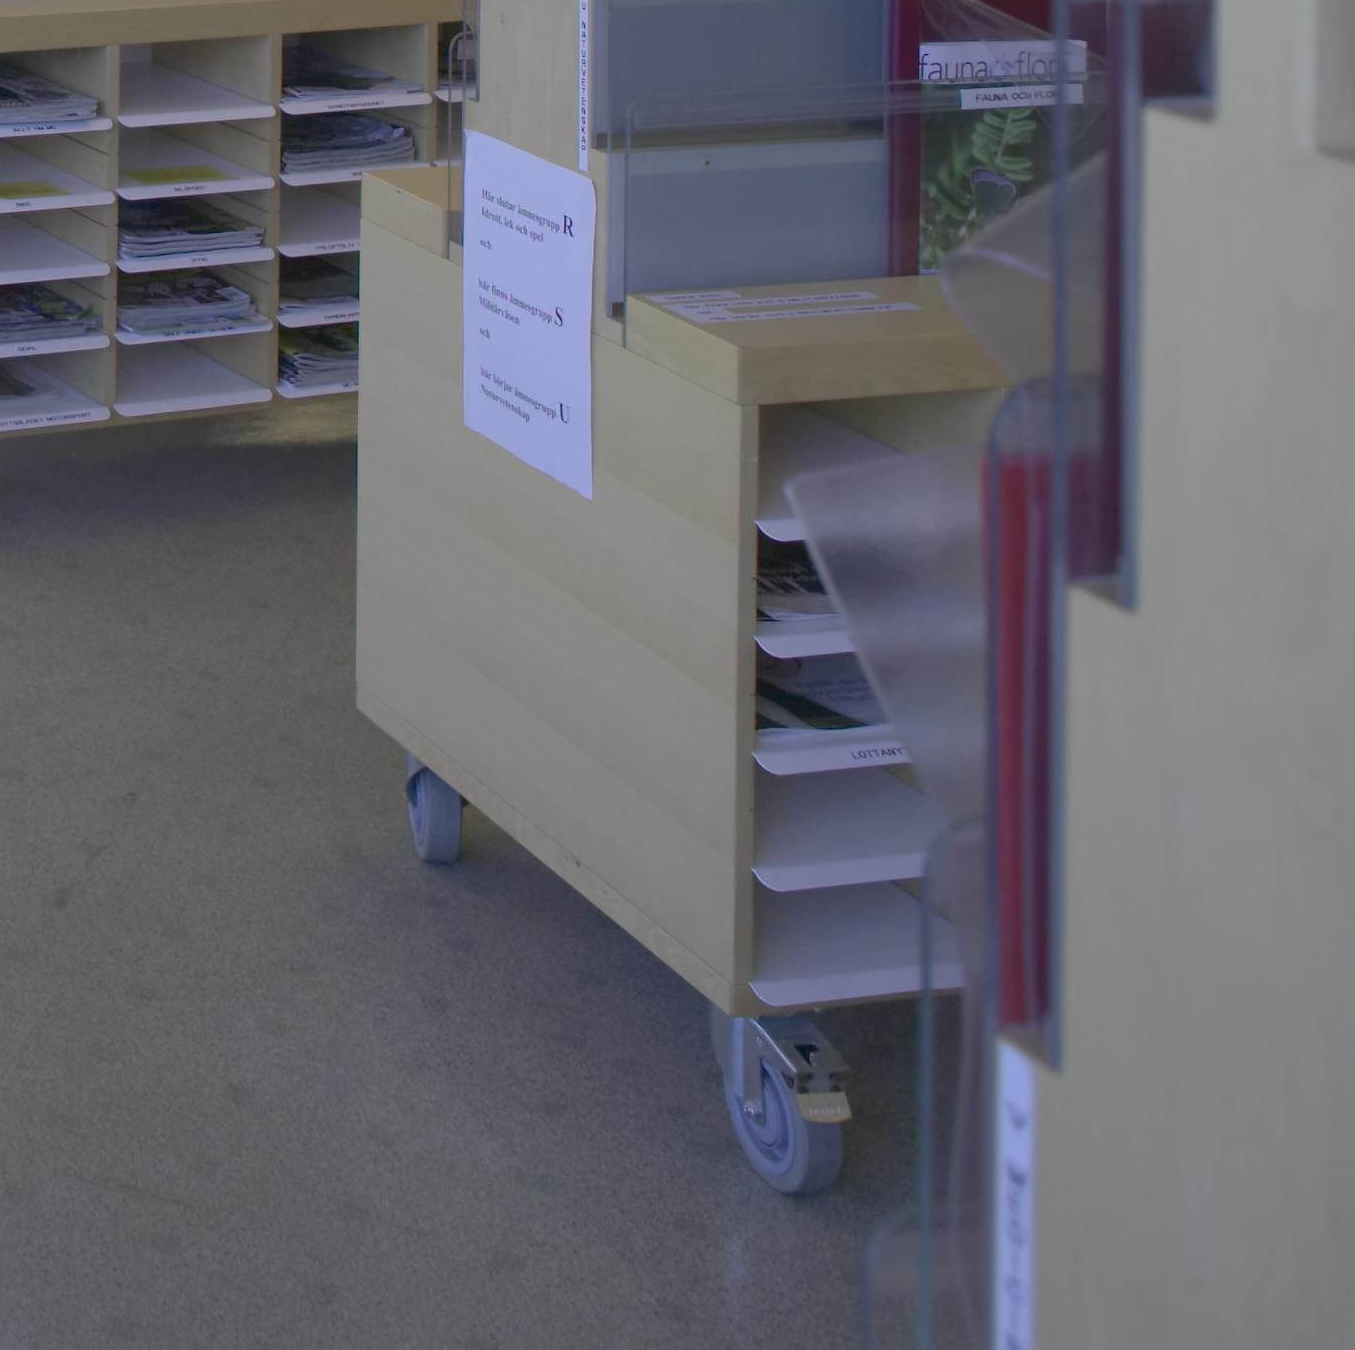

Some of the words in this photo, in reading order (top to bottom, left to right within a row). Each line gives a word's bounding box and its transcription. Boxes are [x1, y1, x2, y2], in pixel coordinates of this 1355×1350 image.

[919, 53, 988, 83] fauna
[1016, 50, 1059, 82] flor
[976, 93, 1009, 103] FAUNA
[481, 188, 495, 202] Här
[562, 214, 575, 239] R
[479, 238, 492, 250] och
[554, 306, 564, 328] S
[559, 402, 572, 424] U
